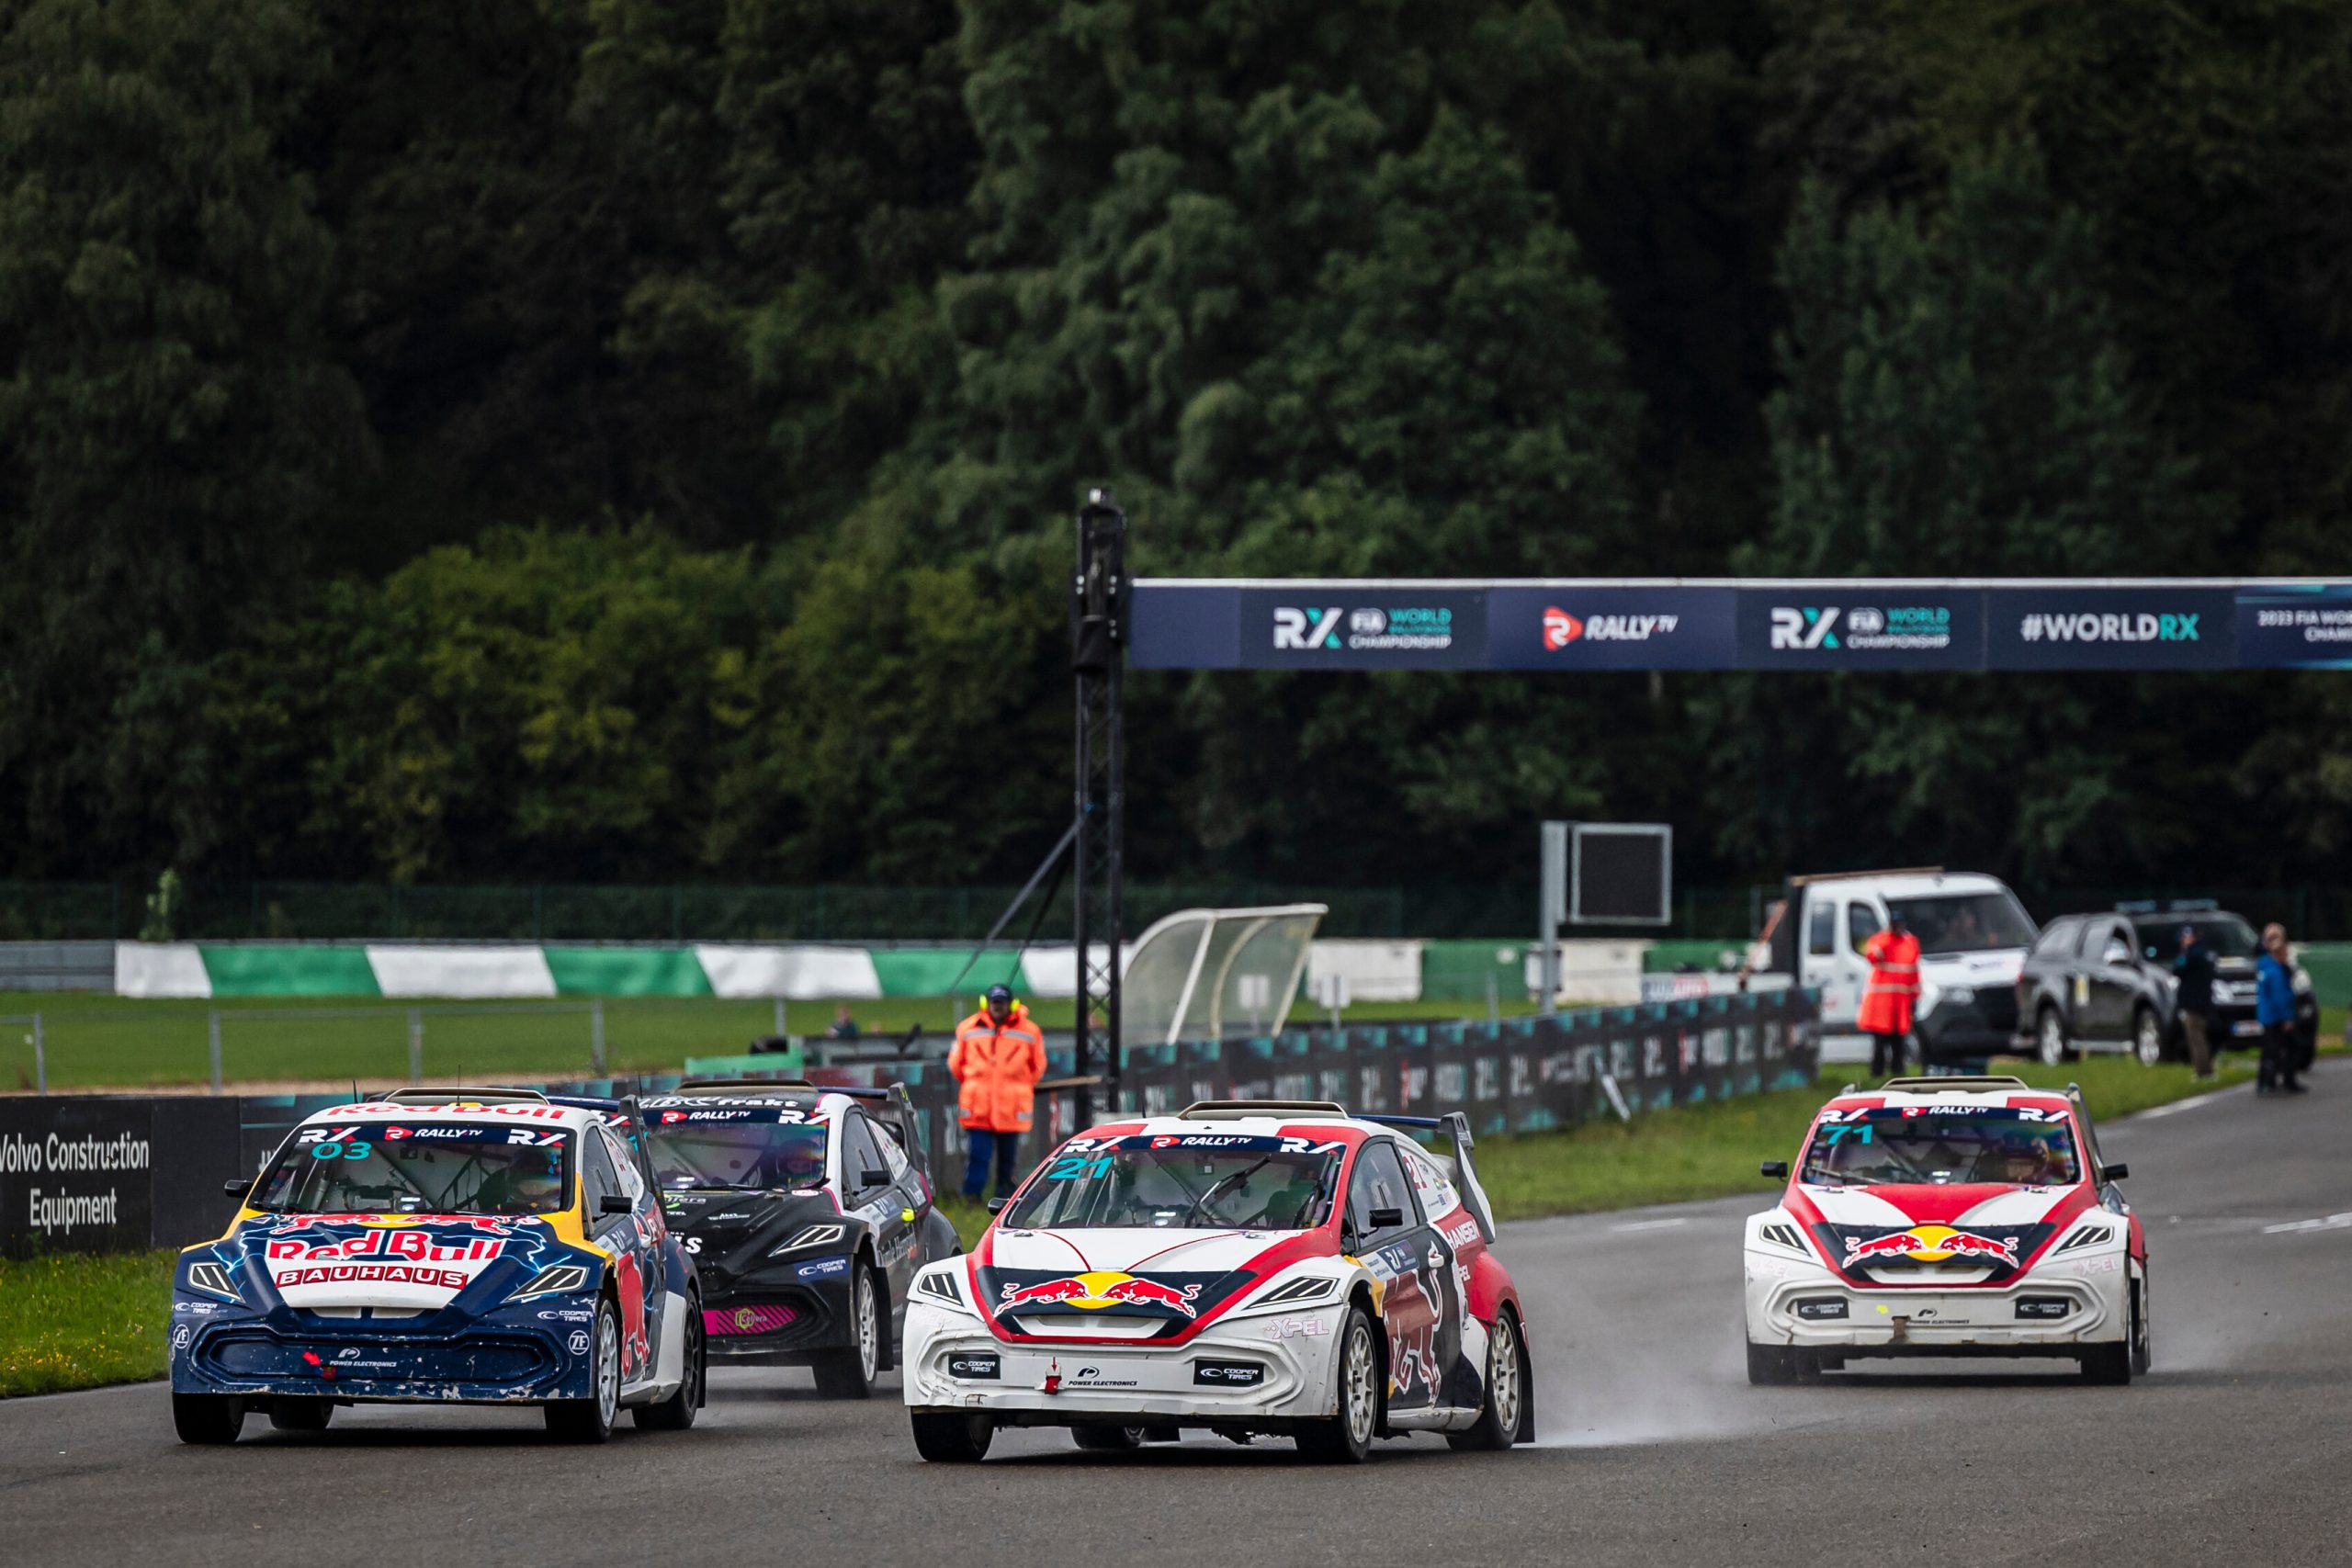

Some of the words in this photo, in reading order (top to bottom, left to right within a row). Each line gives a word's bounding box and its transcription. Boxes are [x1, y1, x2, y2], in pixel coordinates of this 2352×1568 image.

[1389, 608, 1452, 623] WORLD
[1887, 608, 1950, 623] WORLD
[2257, 610, 2294, 626] 2023
[1274, 607, 1343, 649] RX
[1771, 607, 1840, 649] RX
[2021, 613, 2199, 641] #WORLDRX
[299, 1126, 361, 1143] RX
[507, 1129, 567, 1146] RX
[1822, 1124, 1873, 1145] 71
[46, 1132, 149, 1172] Construction
[311, 1142, 372, 1160] 03
[1047, 1157, 1115, 1179] 21
[30, 1187, 117, 1235] Equipment
[268, 1231, 387, 1260] Red
[388, 1232, 504, 1261] Bull
[817, 1259, 846, 1269] COOPER
[822, 1265, 843, 1273] TIRES
[278, 1267, 463, 1286] BAUHAUS
[1272, 1317, 1330, 1339] XPEL
